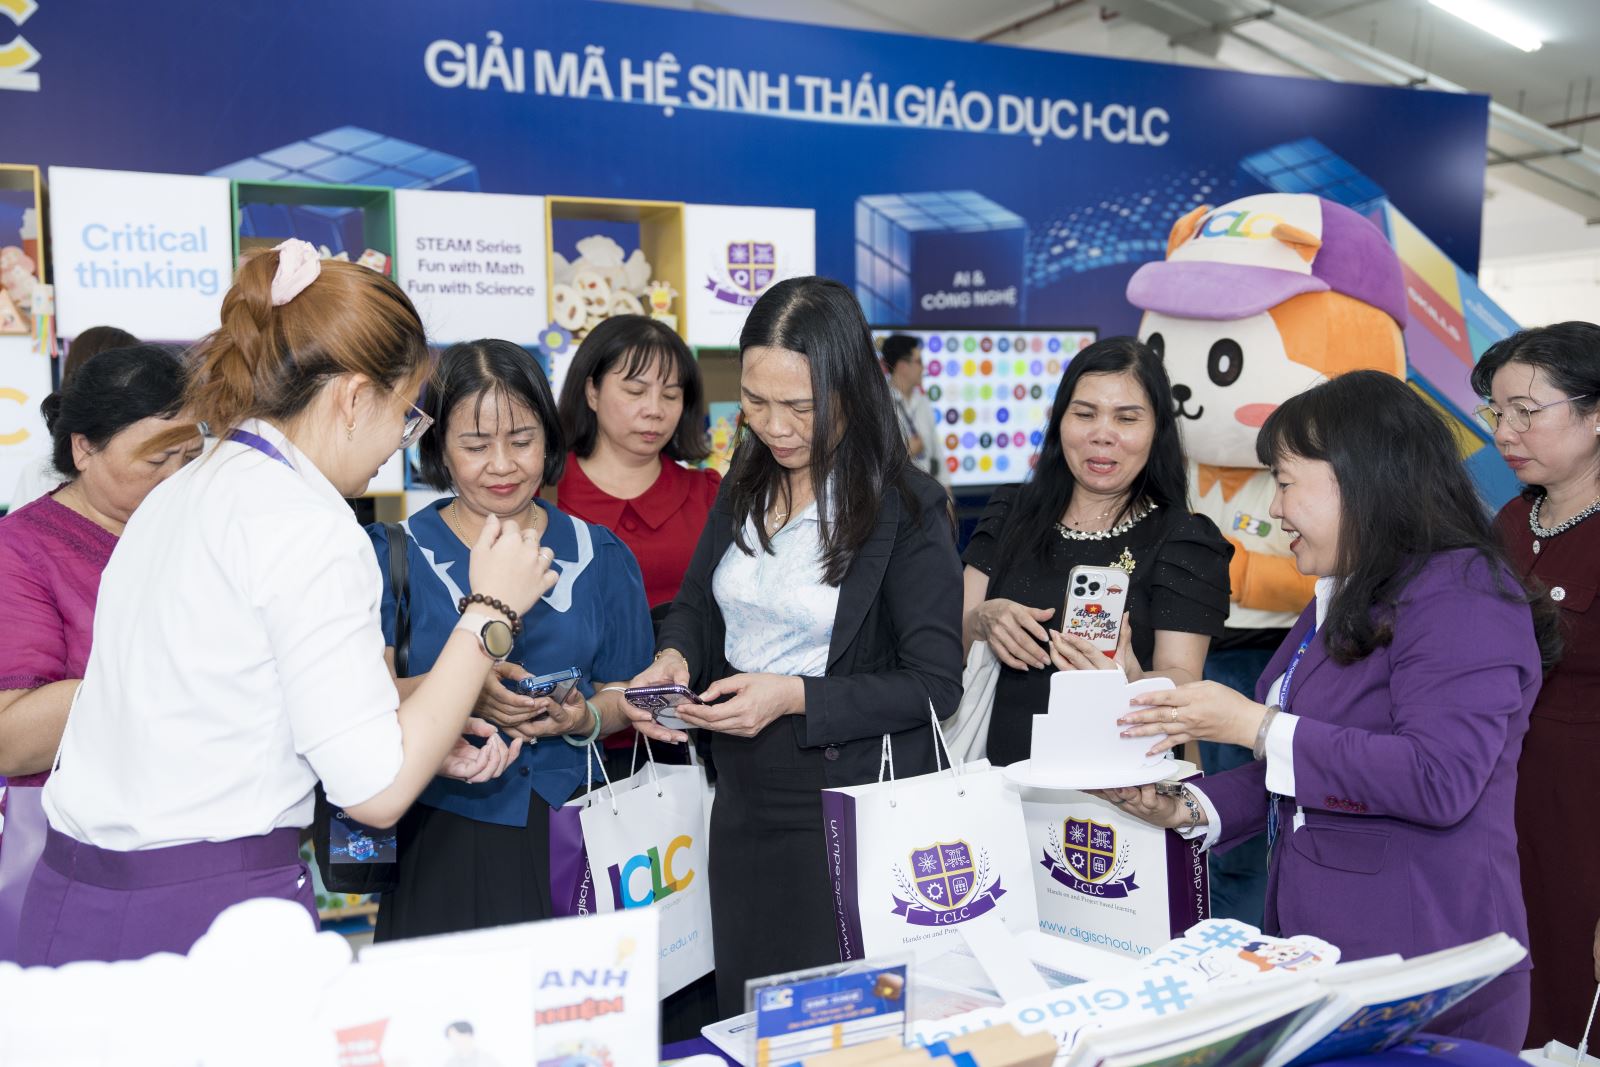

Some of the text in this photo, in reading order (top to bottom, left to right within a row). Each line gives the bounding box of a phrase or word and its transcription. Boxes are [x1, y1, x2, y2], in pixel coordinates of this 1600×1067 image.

[424, 30, 1171, 146] GIẢI MÃ HỆ SINH THÁI GIÁO DỤC I-CLC
[81, 223, 208, 254] Critical
[416, 236, 522, 254] STEAM Series
[417, 258, 525, 276] Fun with Math
[75, 259, 219, 296] thinking
[953, 270, 985, 287] AI &
[407, 279, 536, 297] Fun with Science
[921, 287, 1017, 311] CÔNG NGHỆ
[1073, 880, 1105, 896] I-CLC
[934, 907, 971, 924] I-CLC
[902, 933, 922, 944] Hands
[922, 932, 931, 940] on
[932, 929, 943, 938] and
[540, 969, 629, 989] ANH
[1017, 974, 1195, 1025] #Giao
